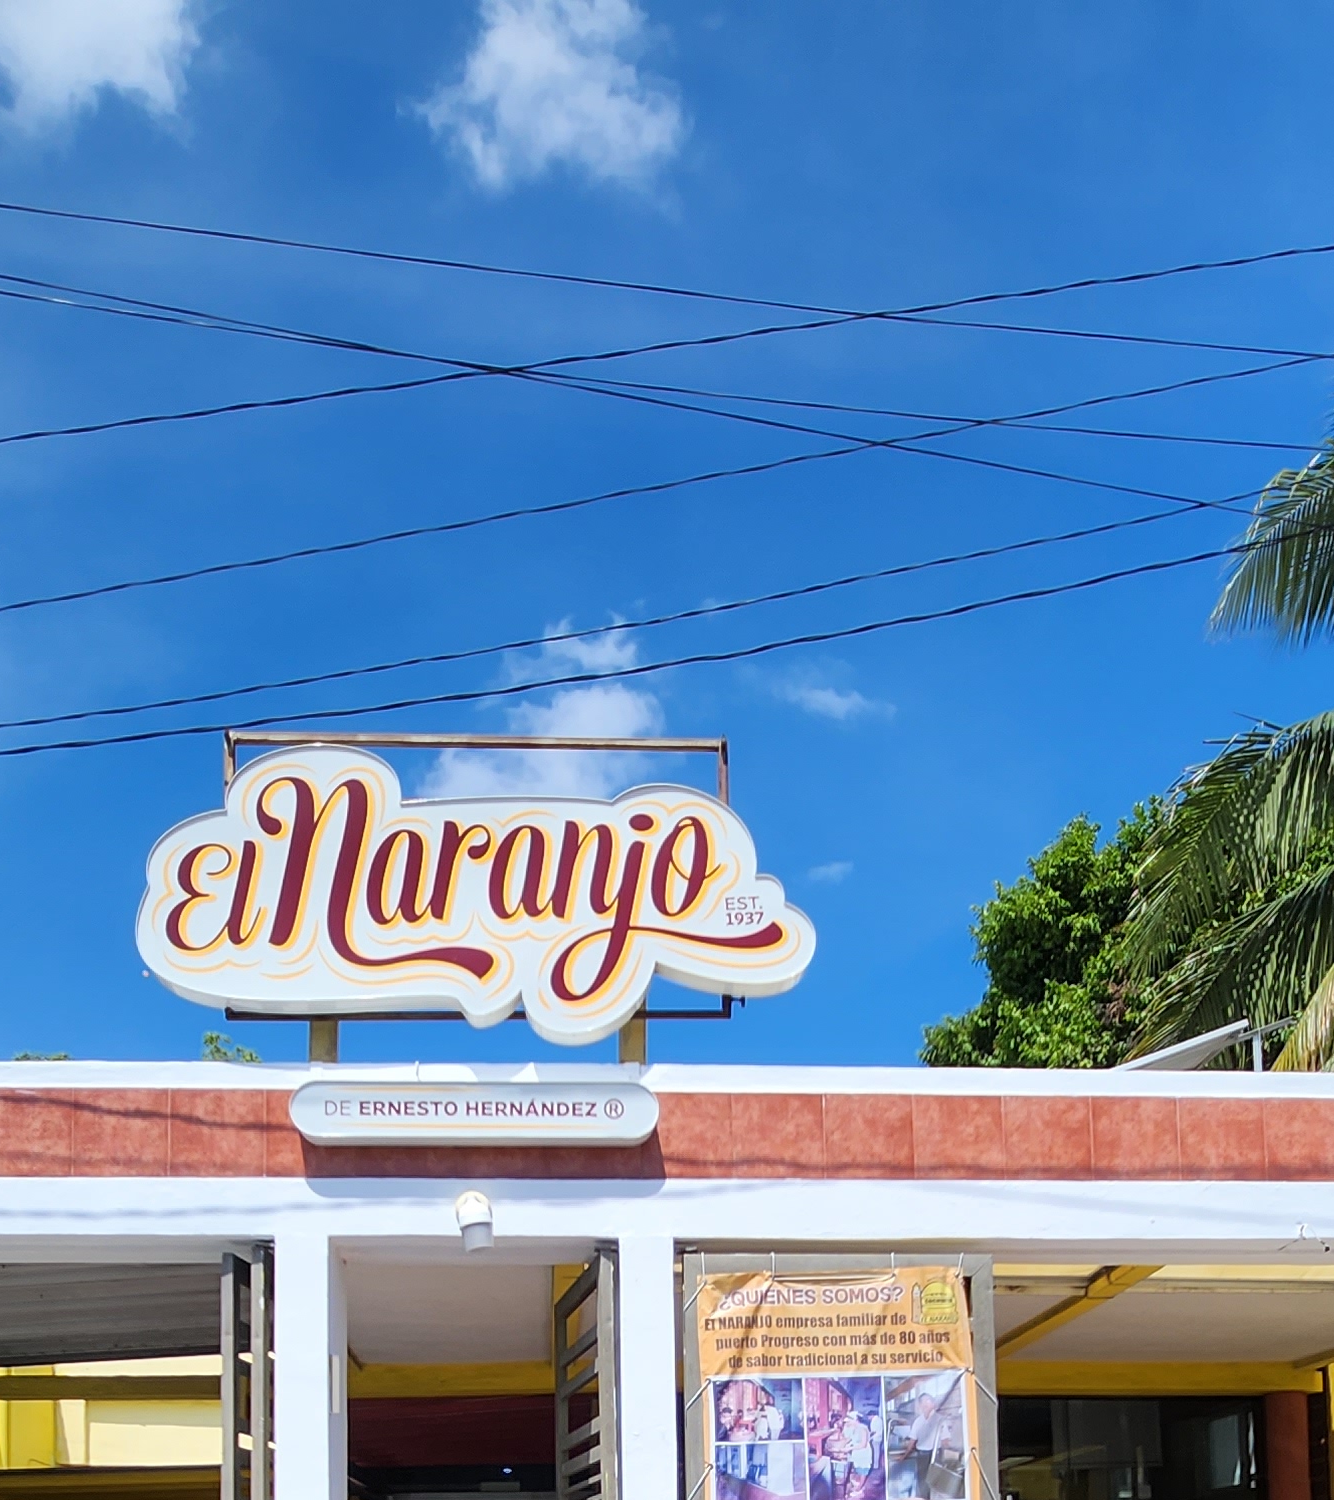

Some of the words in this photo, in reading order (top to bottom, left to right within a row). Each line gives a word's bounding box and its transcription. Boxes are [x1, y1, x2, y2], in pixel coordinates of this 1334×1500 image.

[166, 840, 262, 951] El
[256, 777, 783, 1001] Naranjo
[724, 896, 763, 911] EST.
[726, 911, 764, 926] 1937
[324, 1100, 351, 1116] DE
[358, 1100, 459, 1117] ERNESTO
[465, 1098, 598, 1118] HERNÁNDEZ
[821, 1286, 904, 1304] SOMOS?
[718, 1314, 772, 1330] NARANJO
[776, 1316, 833, 1329] empresa
[836, 1312, 887, 1327] familiar
[890, 1312, 907, 1325] de
[715, 1336, 758, 1351] puerto
[761, 1334, 820, 1349] Progreso
[822, 1335, 847, 1346] con
[849, 1332, 877, 1346] más
[880, 1331, 896, 1345] de
[899, 1330, 916, 1344] 80
[919, 1330, 950, 1344] años
[728, 1354, 743, 1368] de
[746, 1353, 783, 1367] sabor
[785, 1352, 858, 1367] tradicional
[860, 1354, 869, 1365] a
[871, 1353, 887, 1365] su
[889, 1350, 944, 1364] servicio
